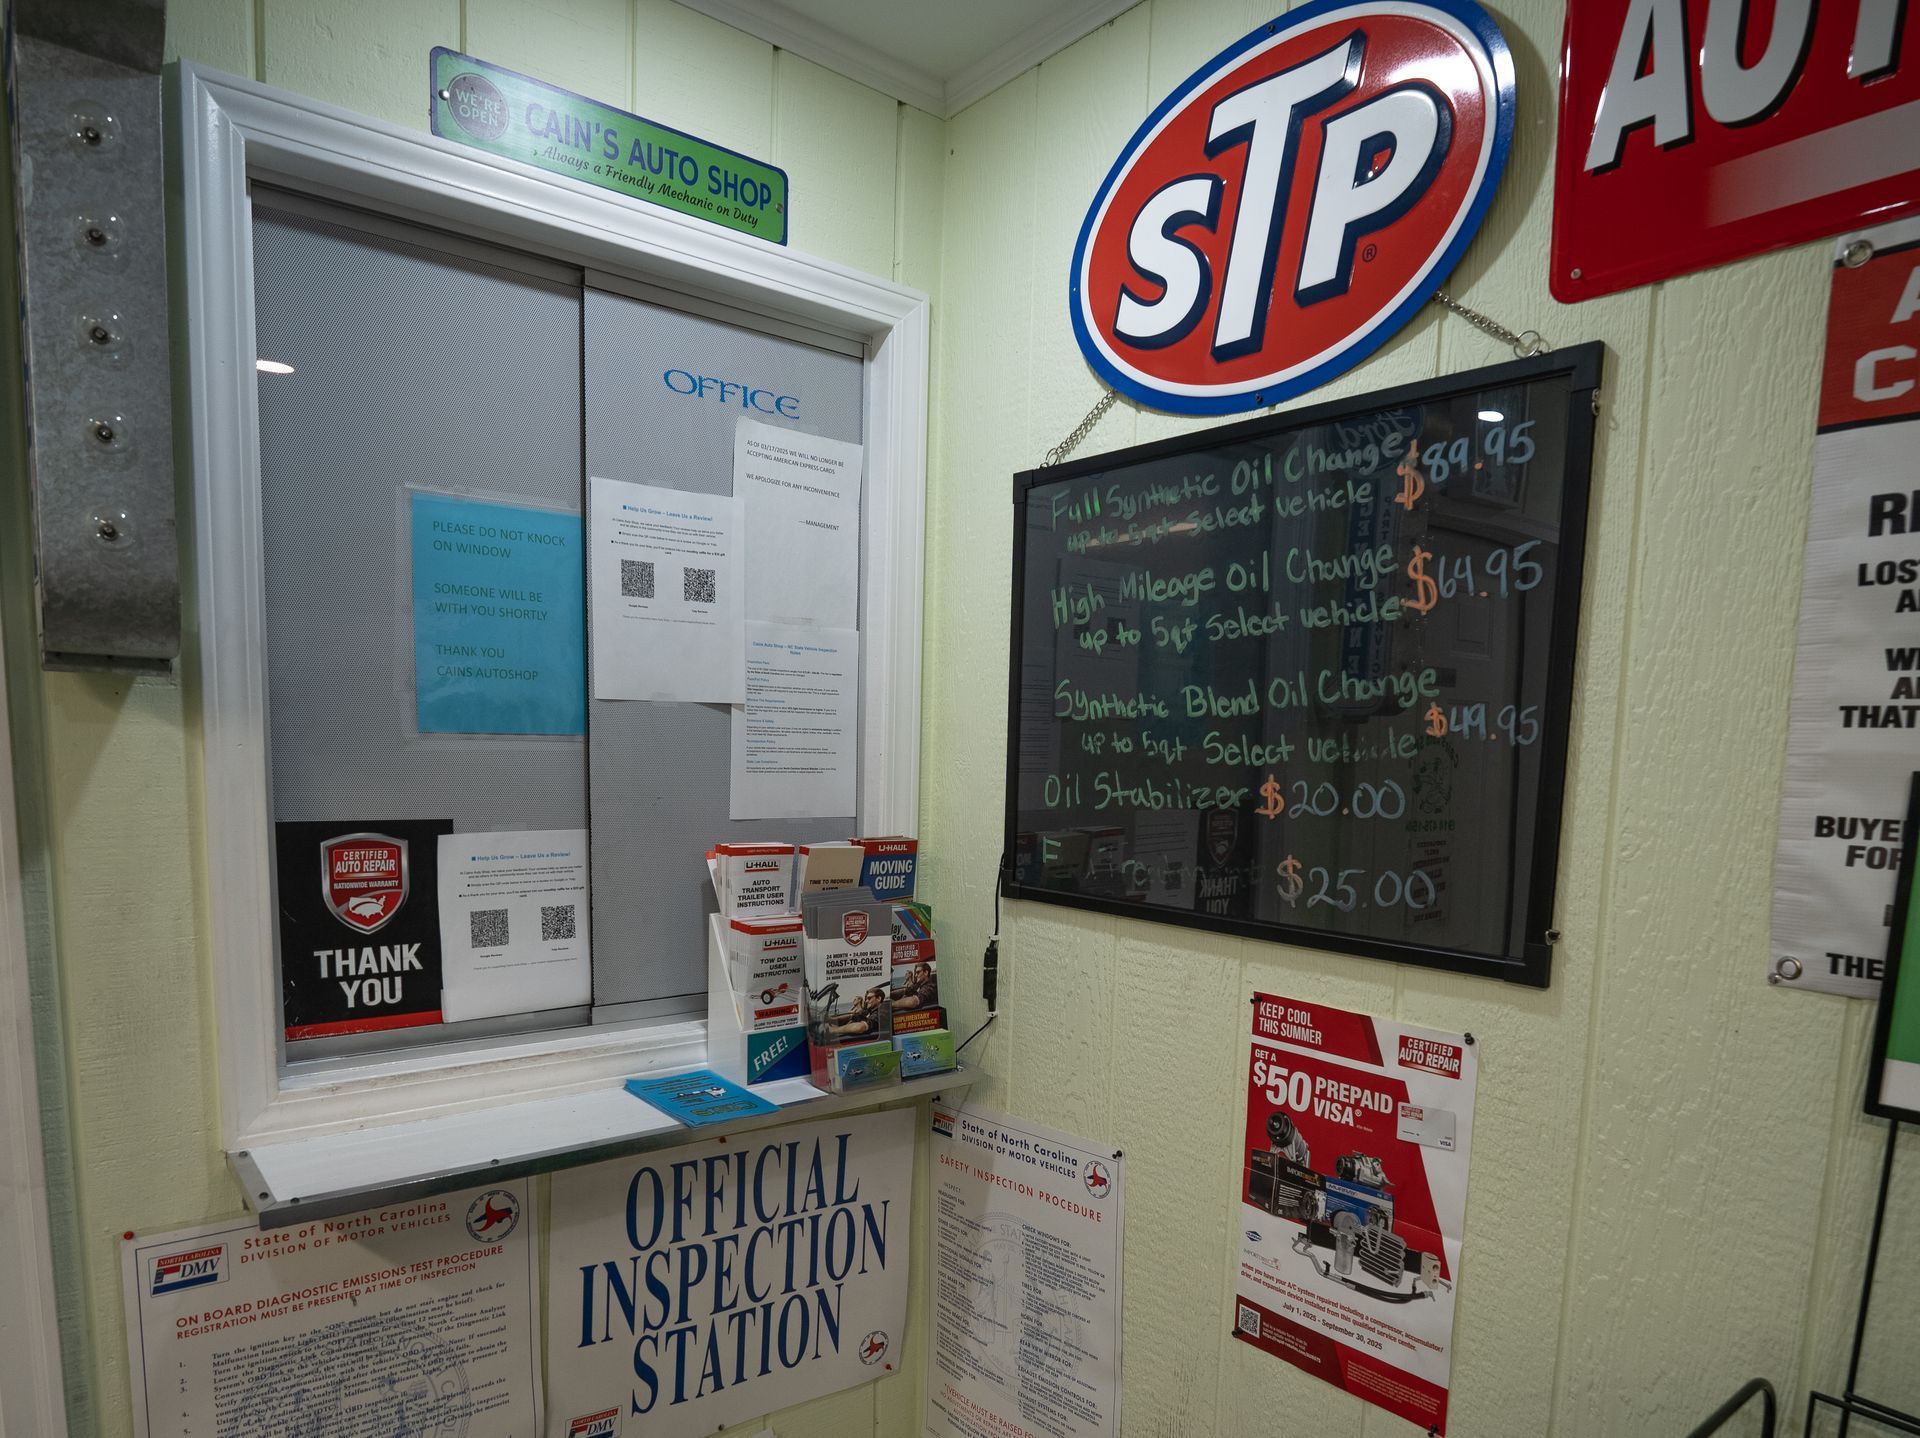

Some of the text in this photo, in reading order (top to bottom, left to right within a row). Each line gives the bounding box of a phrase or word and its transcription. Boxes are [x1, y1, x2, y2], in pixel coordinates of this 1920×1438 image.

[455, 87, 501, 115] WE'RE
[459, 104, 499, 127] OPEN
[524, 102, 772, 212] CAIN'S AUTO SHOP
[541, 145, 759, 230] Always a Friendly Mechanic on Duty
[1113, 28, 1455, 363] STP
[663, 368, 801, 420] OFFICE
[747, 449, 835, 475] ACCEPTING AMERICAN EXPRESS CARDS
[789, 450, 797, 458] WE
[798, 452, 809, 460] WILL
[818, 457, 838, 467] LONGER
[746, 472, 840, 498] WE APOLOGIZE FOR ANY INCONVENIENCE
[1050, 432, 1404, 532] Full Synthetic Oil Change
[1067, 531, 1091, 554] up
[1099, 525, 1119, 545] to
[1275, 480, 1374, 518] vehicle
[433, 520, 565, 547] PLEASE DO NOT KNOCK
[433, 540, 512, 559] ON WINDOW
[434, 582, 543, 603] SOMEONE WILL BE
[1051, 544, 1400, 629] High Mileage Oil Change
[435, 602, 548, 622] WITH YOU SHORTLY
[1079, 626, 1108, 655] up
[1116, 621, 1142, 648] to
[1300, 590, 1402, 629] vehicle
[436, 644, 505, 659] THANK YOU
[437, 665, 539, 681] CAINS AUTOSHOP
[1054, 667, 1441, 721] Synthetic Blend Oil Change
[1839, 704, 1920, 729] THAT
[1111, 731, 1134, 753] to
[1044, 770, 1406, 820] Oil Stabilizer $20.00
[1814, 815, 1903, 842] BUYE
[343, 850, 389, 861] CERTIFIED
[879, 844, 908, 852] U-HAUL
[335, 859, 396, 873] AUTO REPAIR
[745, 861, 779, 869] U-HAUL
[869, 859, 913, 876] MOVING
[333, 879, 399, 890] NATIONWIDE WARRANTY
[742, 885, 781, 894] TRANSPORT
[874, 875, 906, 890] GUIDE
[1276, 854, 1437, 912] $25.00
[736, 899, 785, 909] INSTRUCTIONS
[737, 894, 766, 902] TRAILER
[764, 938, 797, 947] U-HAUL
[313, 942, 423, 979] THANK
[760, 954, 798, 965] TOW DOLLY
[769, 963, 787, 971] USER
[826, 957, 883, 969] COAST-TO-COAST
[753, 967, 801, 979] INSTRUCTIONS
[339, 975, 403, 1009] YOU
[1259, 1001, 1313, 1028] KEEP COOL
[1258, 1016, 1323, 1046] THIS SUMMER
[753, 1035, 788, 1072] FREE!
[1254, 1048, 1277, 1062] GET A
[1399, 1047, 1460, 1073] AUTO REPAIR
[1407, 1038, 1454, 1058] CERTIFIED
[1252, 1059, 1312, 1112] $50
[1314, 1075, 1393, 1115] PREPAID
[961, 1119, 1079, 1167] State of North Carolina
[961, 1133, 1076, 1179] DIVISION OF MOTOR VEHICLES
[626, 1133, 860, 1252] OFFICIAL
[939, 1153, 1103, 1223] SAFETY INSPECTION PROCEDURE
[240, 1213, 451, 1264] DIVISION OF MOTOR VEHICLES
[243, 1201, 448, 1250] State of North Carolina
[158, 1247, 222, 1267] NORTH CAROLINA
[180, 1257, 221, 1279] DMV
[175, 1244, 504, 1329] ON BOARD DIAGNOSTIC EMISSIONS TEST PROCEDURE
[578, 1200, 890, 1348] INSPECTION
[1282, 1301, 1295, 1314] July
[1302, 1309, 1317, 1322] 2025
[1321, 1318, 1355, 1340] September
[1356, 1331, 1366, 1345] 30,
[1366, 1336, 1383, 1351] 2025
[631, 1283, 844, 1418] STATION
